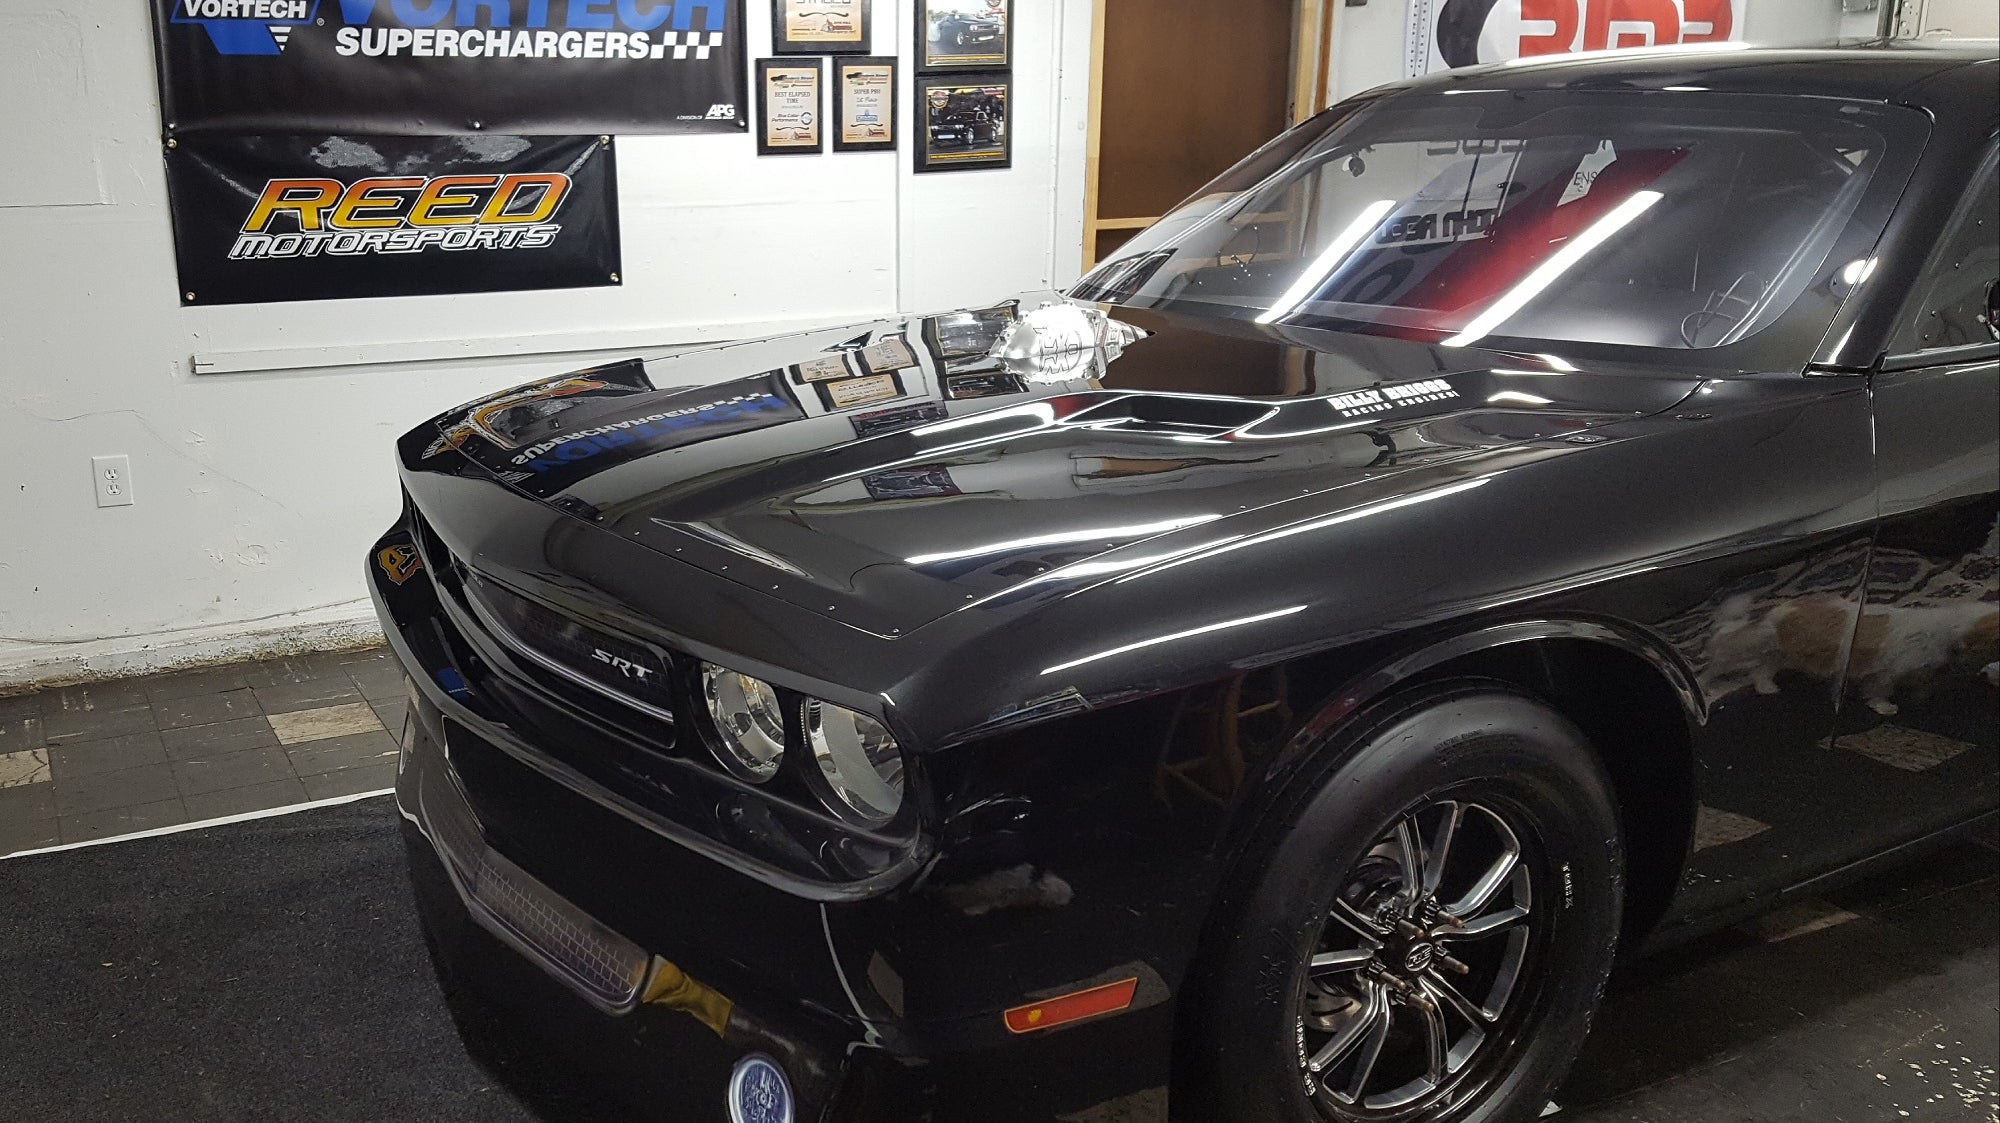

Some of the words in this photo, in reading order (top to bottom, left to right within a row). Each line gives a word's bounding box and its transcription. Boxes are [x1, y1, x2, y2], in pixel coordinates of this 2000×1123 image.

[184, 0, 307, 19] VORTECH
[335, 27, 650, 59] SUPERCHARGERS
[705, 103, 736, 117] APG
[239, 172, 573, 233] REED
[227, 224, 563, 261] MOTORSPORTS
[1326, 389, 1384, 411] BILLY
[1381, 378, 1452, 400] BRIGGS
[1341, 402, 1393, 418] RACING
[591, 648, 654, 678] SRT
